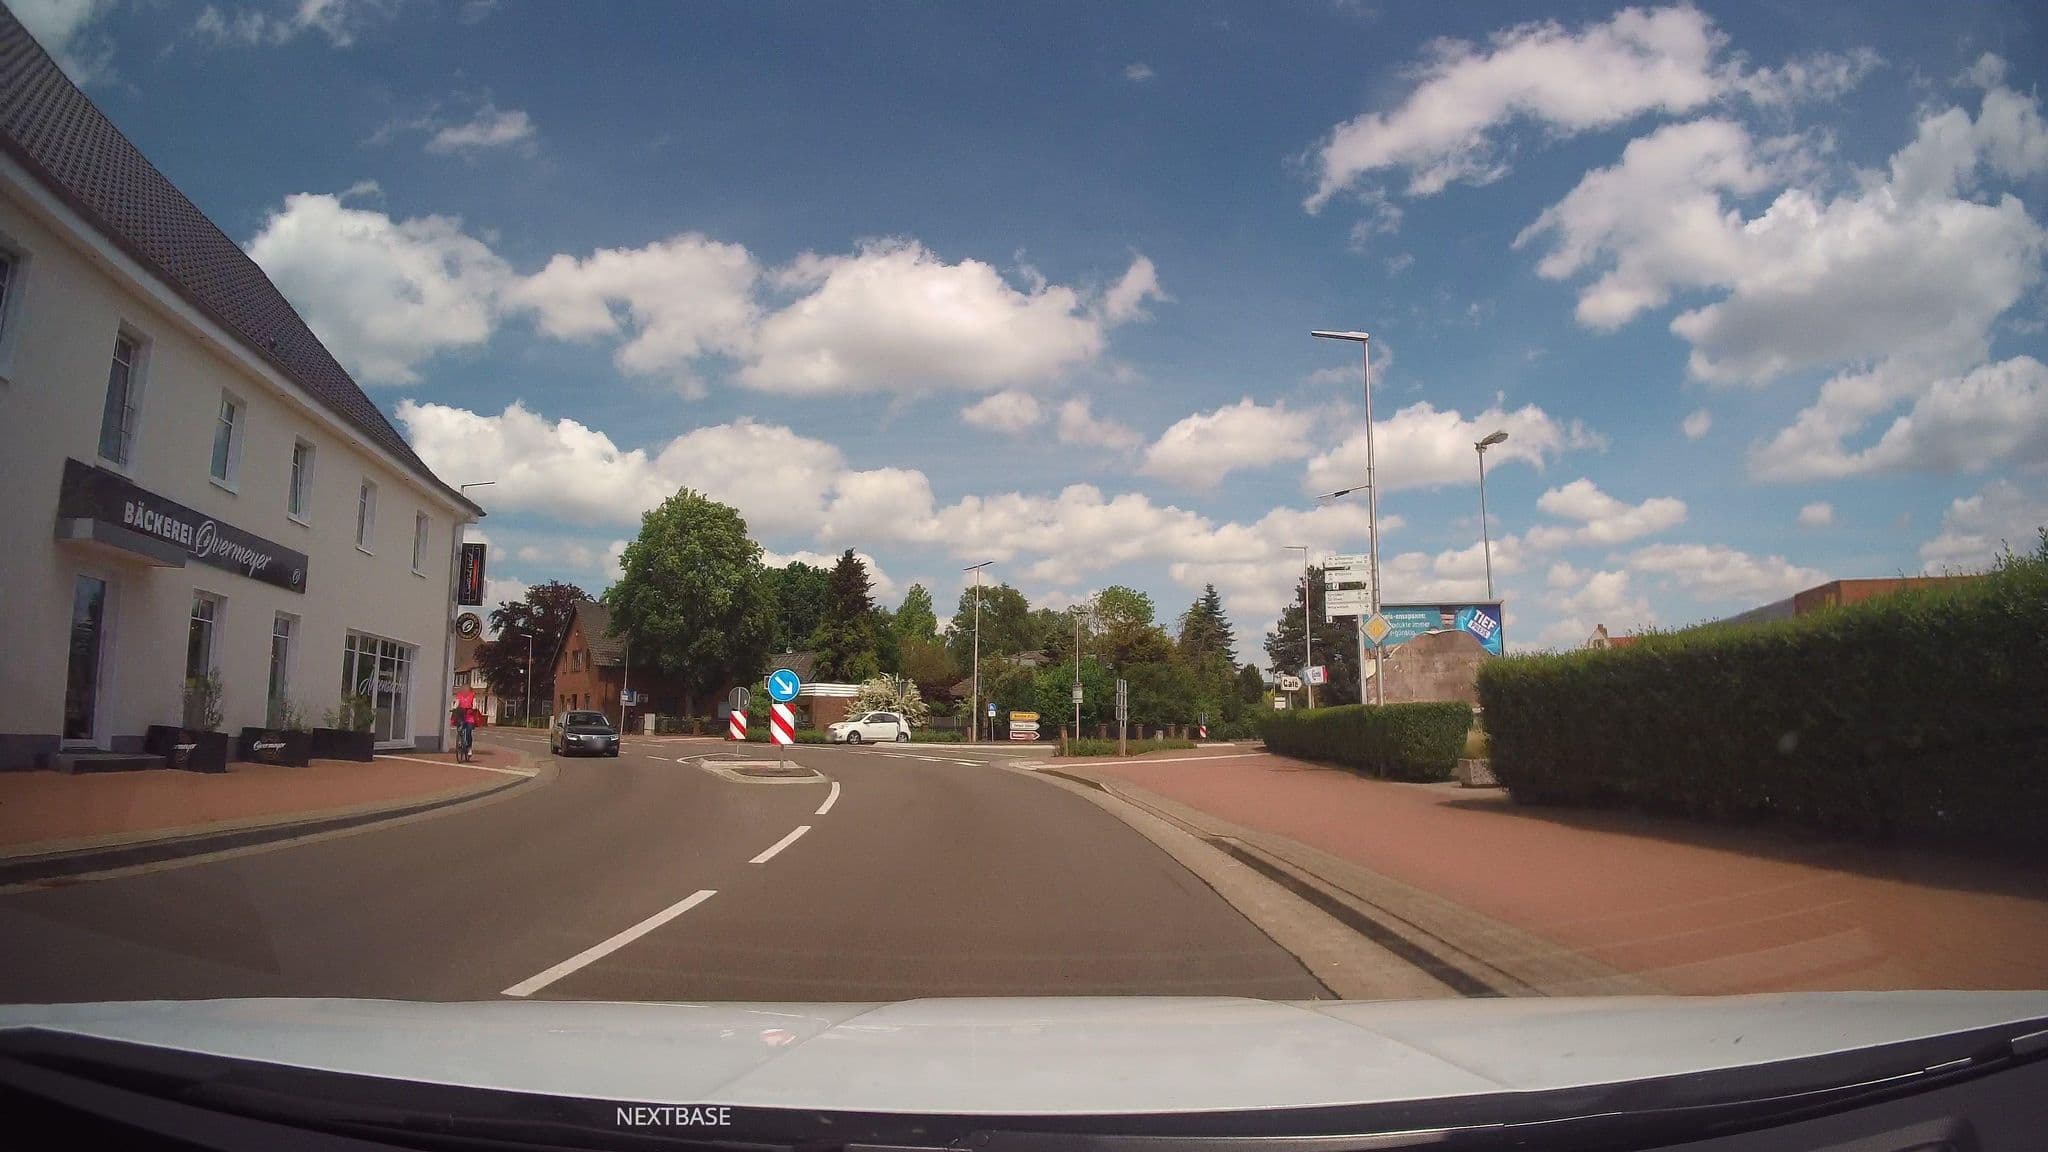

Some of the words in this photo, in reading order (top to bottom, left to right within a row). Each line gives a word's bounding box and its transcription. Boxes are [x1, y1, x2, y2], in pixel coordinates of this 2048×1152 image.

[123, 501, 193, 545] BÄCKEREI
[193, 520, 273, 576] Overmeyer
[1474, 609, 1497, 630] TIEF
